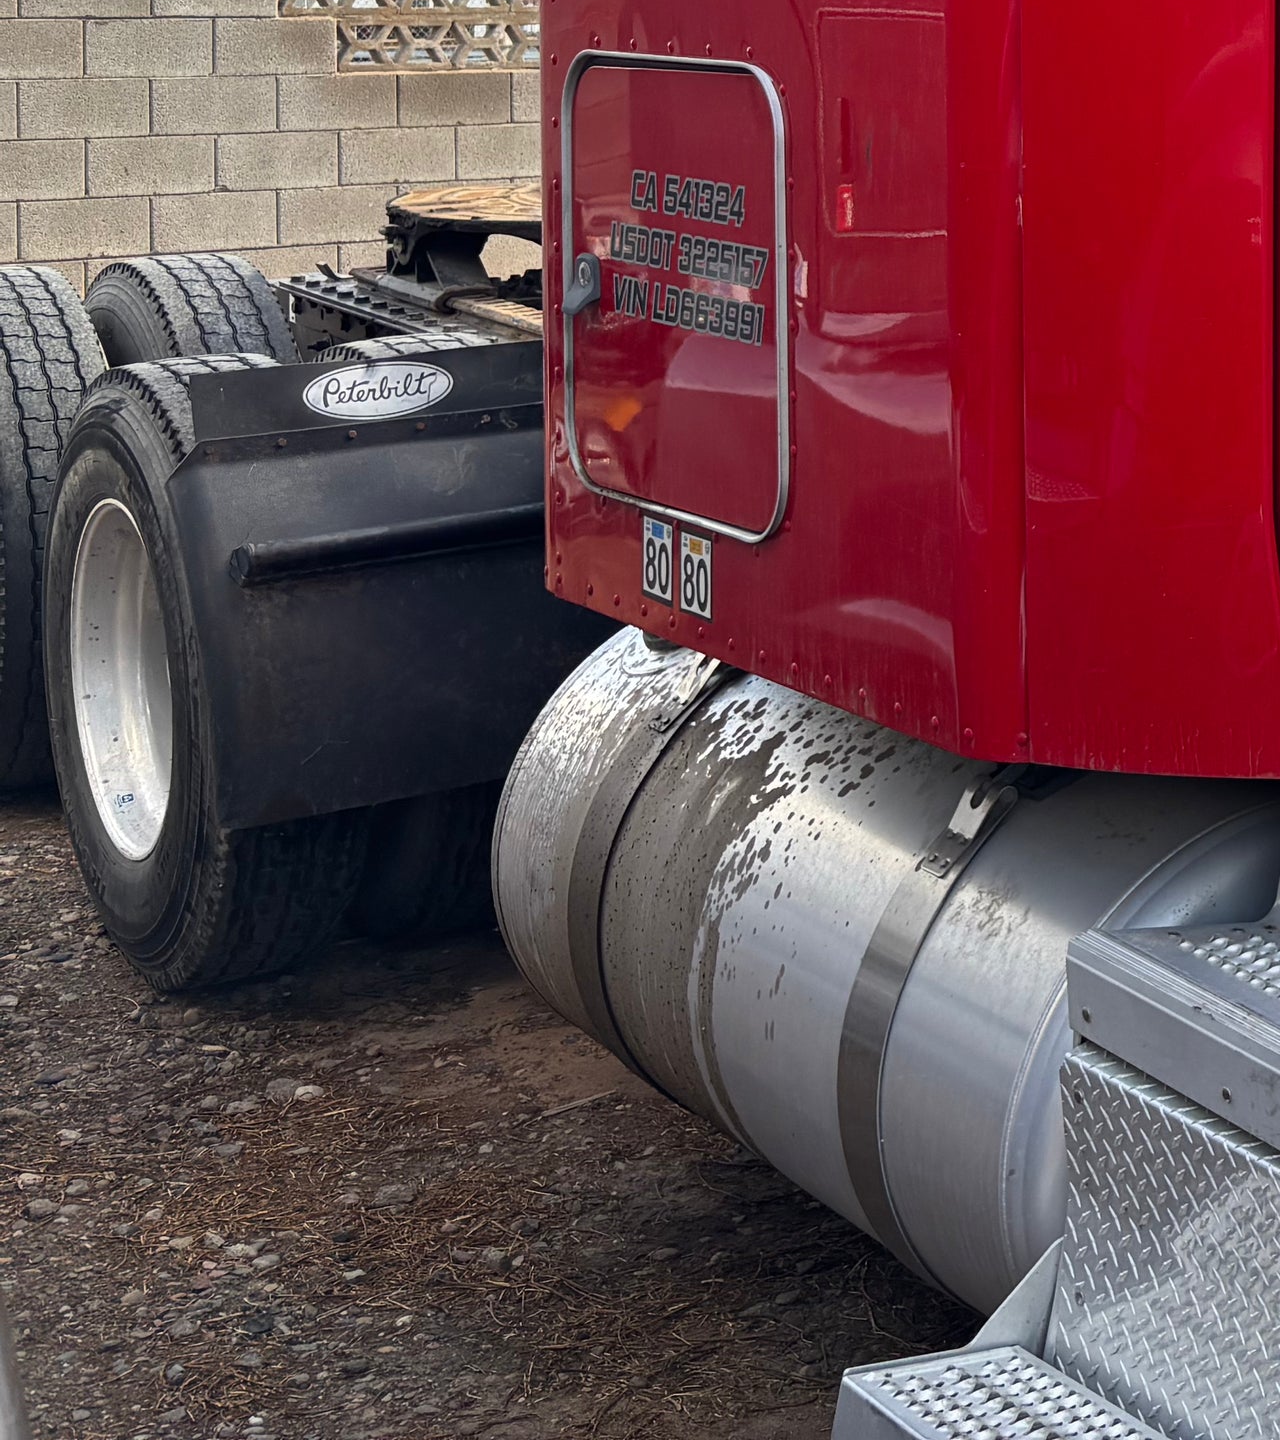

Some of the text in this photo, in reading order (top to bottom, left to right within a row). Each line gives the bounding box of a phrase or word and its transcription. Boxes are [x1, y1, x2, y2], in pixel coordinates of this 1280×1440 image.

[630, 169, 746, 227] CA 541324
[610, 220, 769, 289] USDOT 3225157
[613, 273, 765, 347] VIN LD663991
[322, 372, 437, 408] Peterbilt
[645, 537, 670, 595] 80
[683, 553, 709, 613] 80
